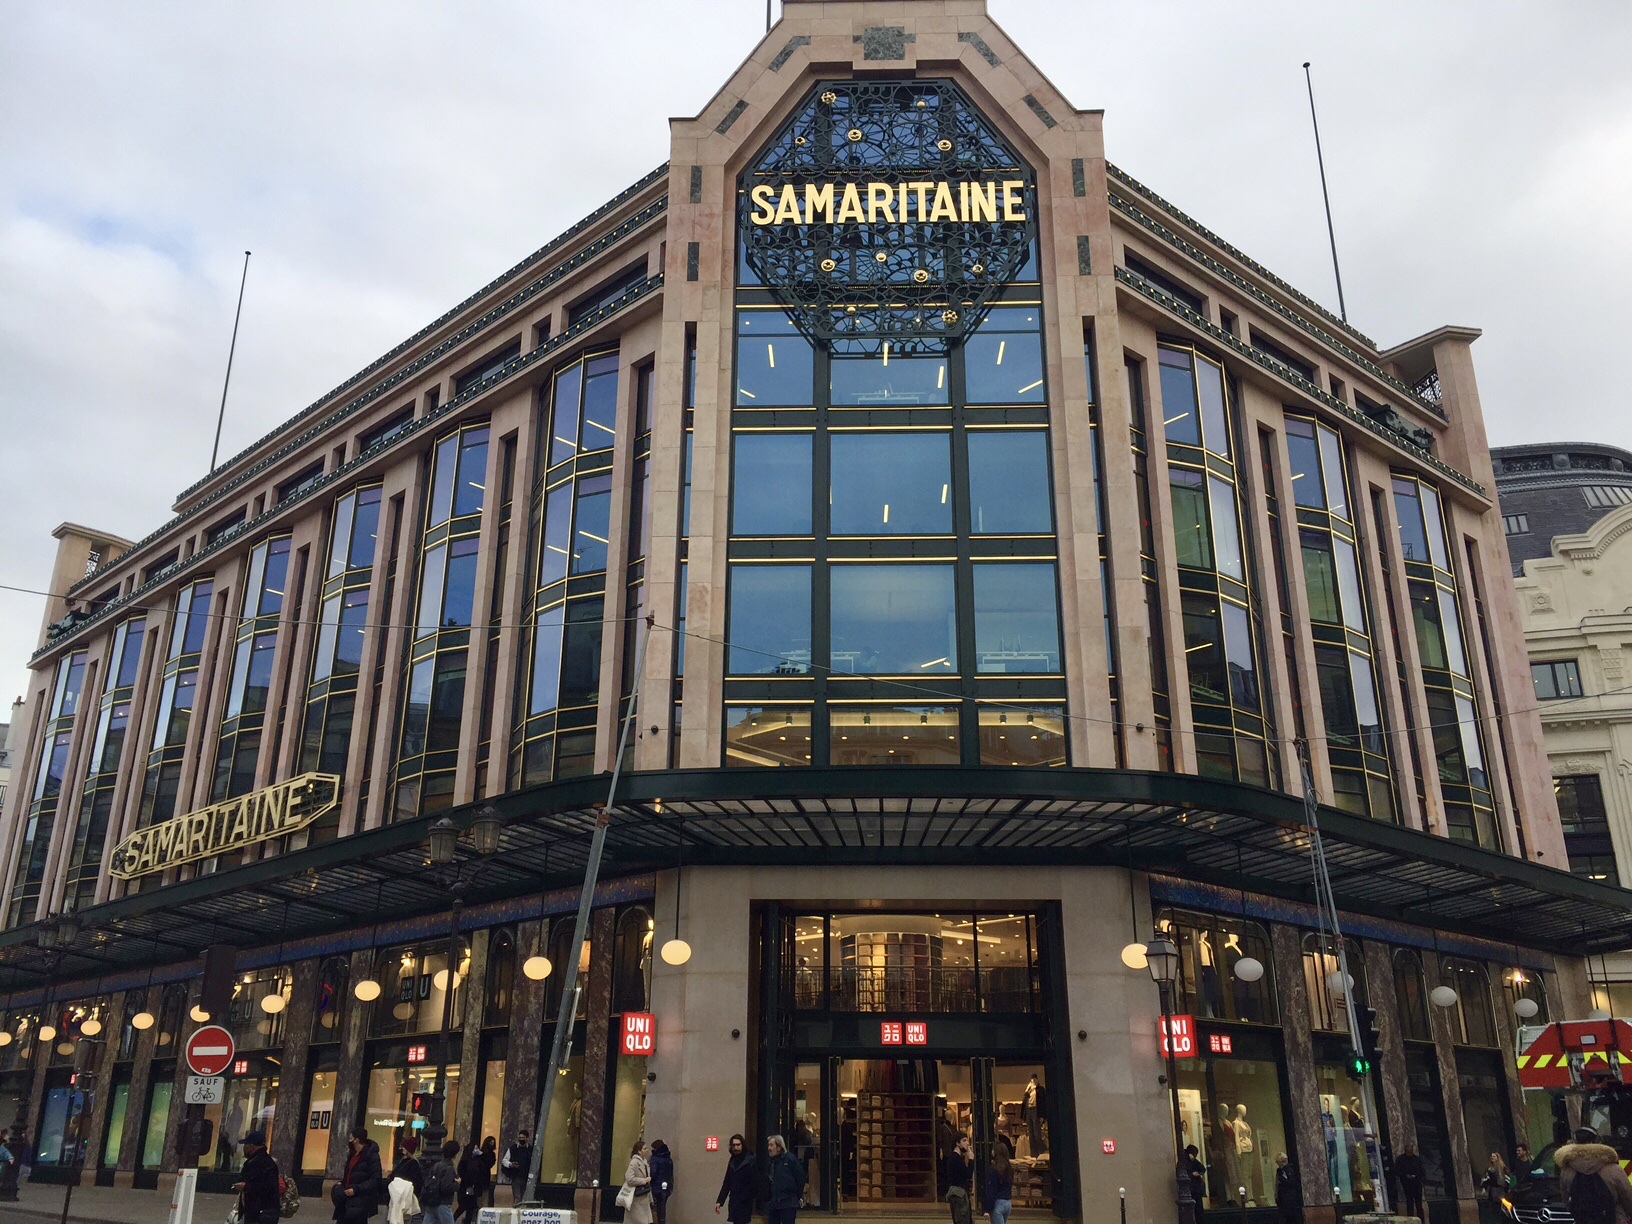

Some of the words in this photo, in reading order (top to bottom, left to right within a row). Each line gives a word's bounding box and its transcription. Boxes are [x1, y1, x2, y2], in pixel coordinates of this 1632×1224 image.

[750, 180, 1026, 226] SAMARITAINE
[124, 779, 308, 873] SAMARITAINE
[627, 1017, 650, 1033] UNI
[907, 1025, 923, 1033] UNI
[626, 1034, 651, 1052] QLO
[907, 1033, 925, 1043] QLO
[322, 1112, 329, 1127] U
[522, 1210, 561, 1219] Courage,
